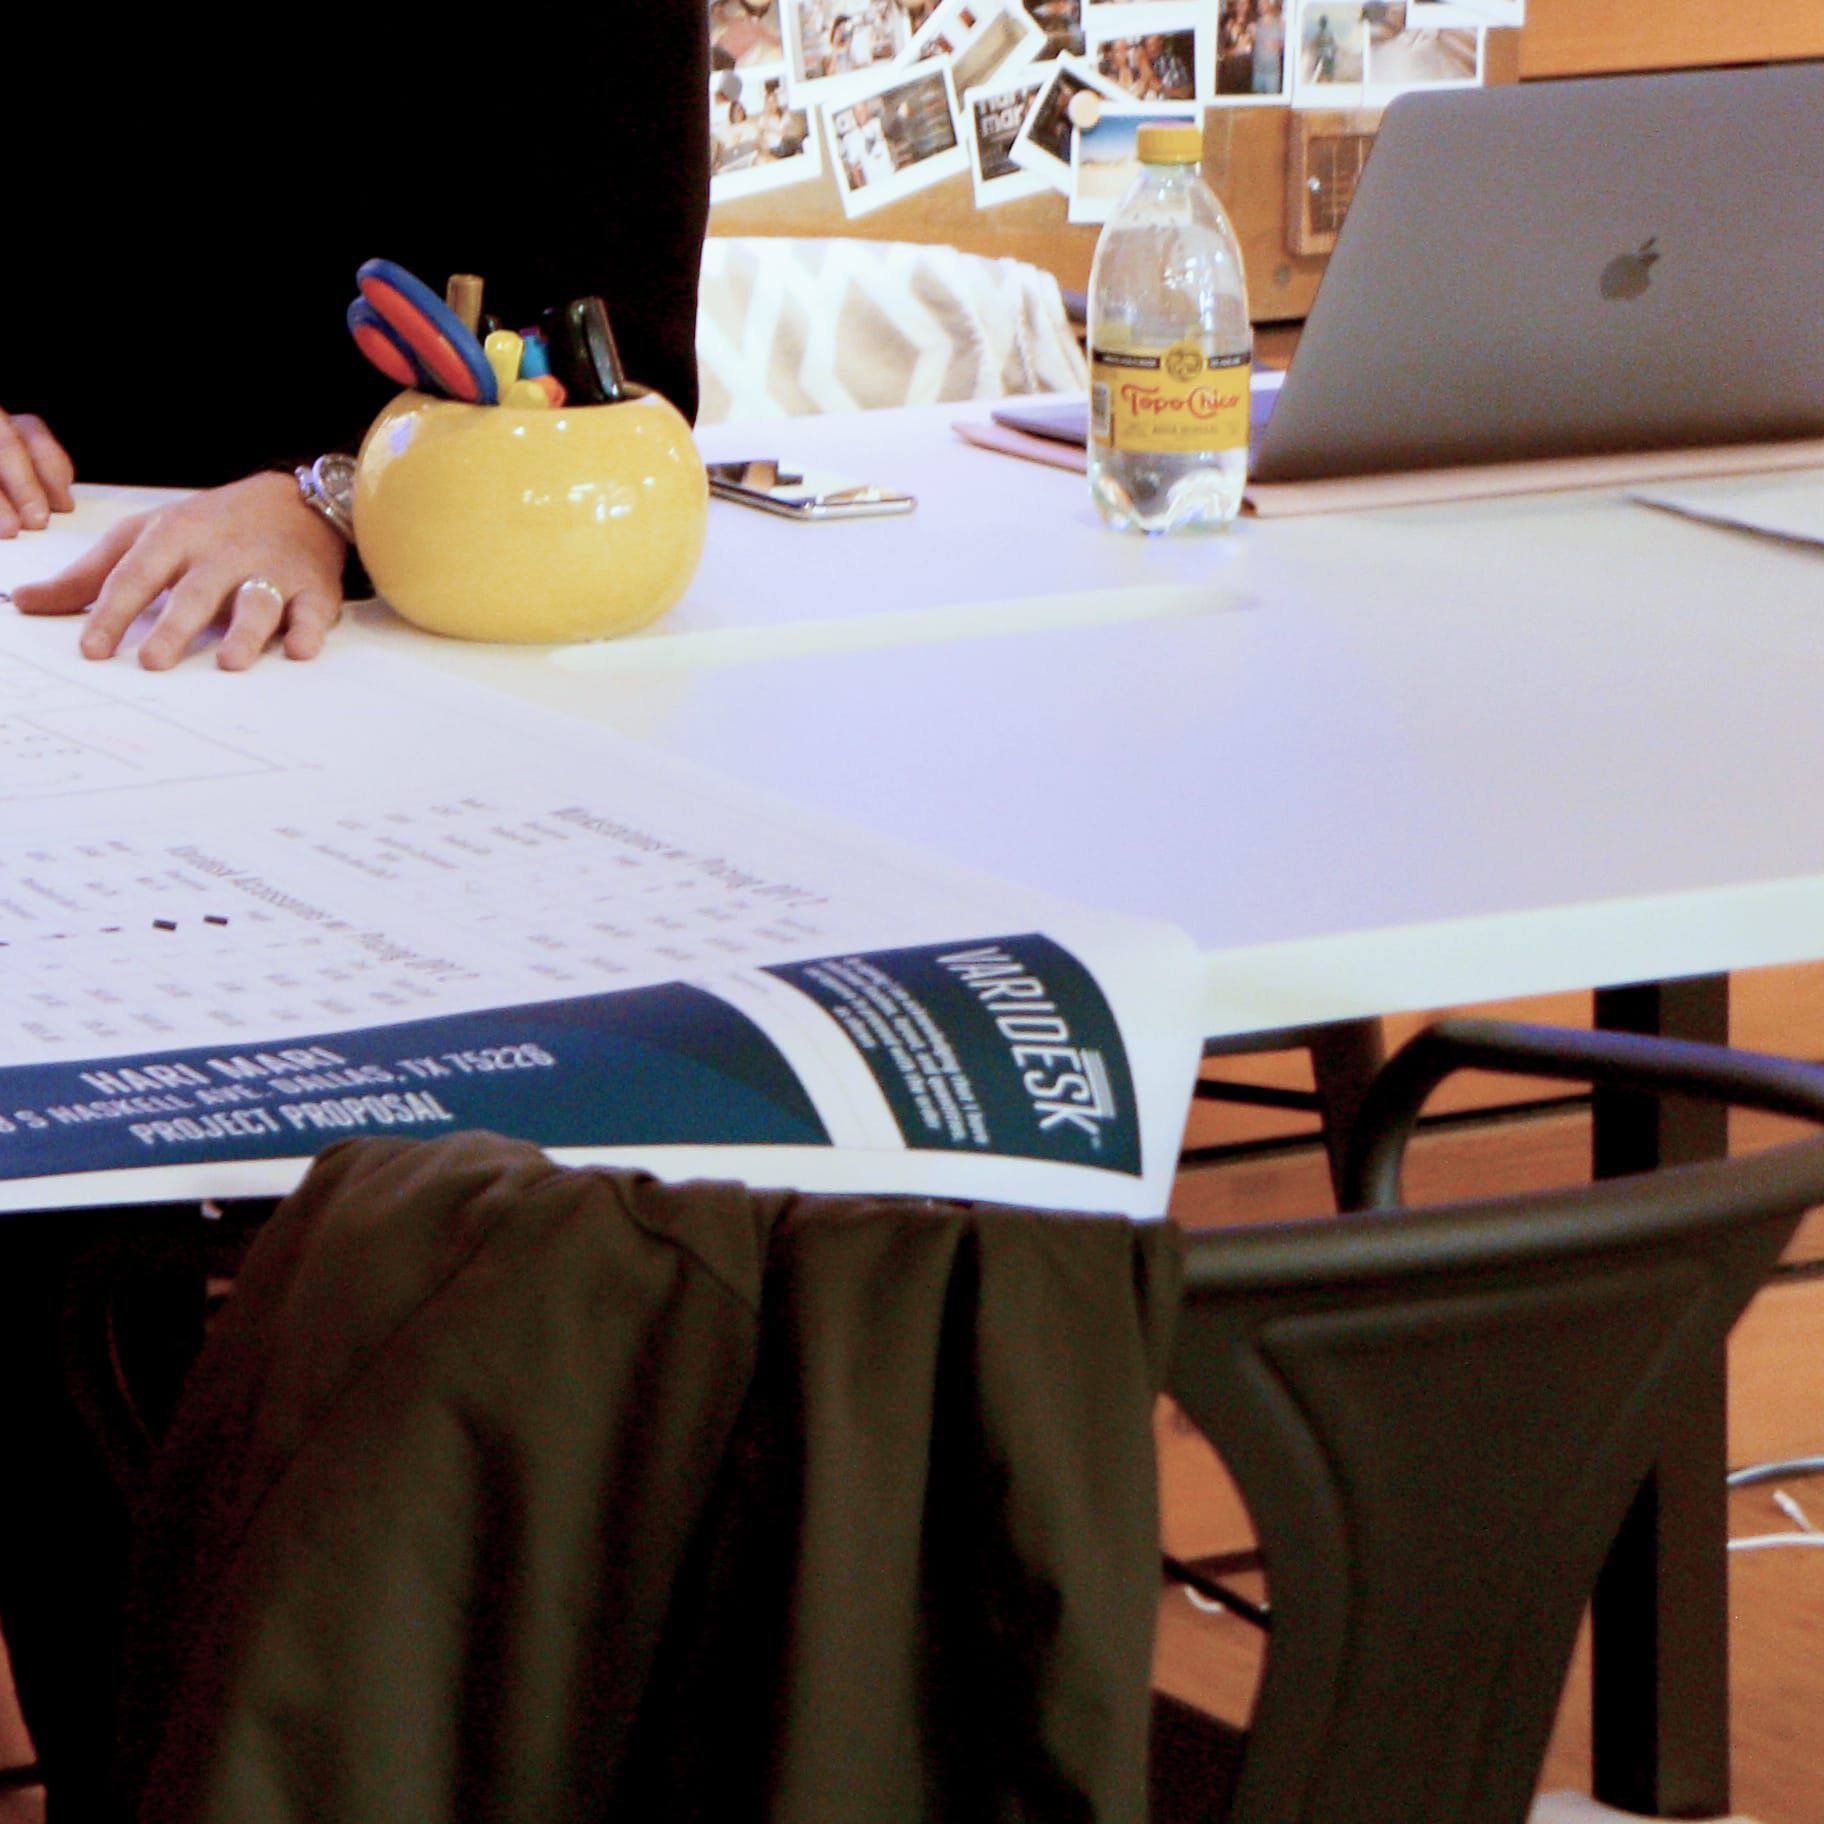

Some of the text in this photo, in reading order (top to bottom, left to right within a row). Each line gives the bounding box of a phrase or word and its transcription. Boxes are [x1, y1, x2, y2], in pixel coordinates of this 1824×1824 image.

[1121, 383, 1240, 420] Topo Chico
[80, 1045, 347, 1095] HARI MARI
[936, 945, 1102, 1140] VARIDESK
[14, 1108, 49, 1129] S
[45, 1093, 197, 1125] HASKELL
[397, 1056, 451, 1080] TX
[128, 1089, 457, 1146] PROJECT PROPOSAL
